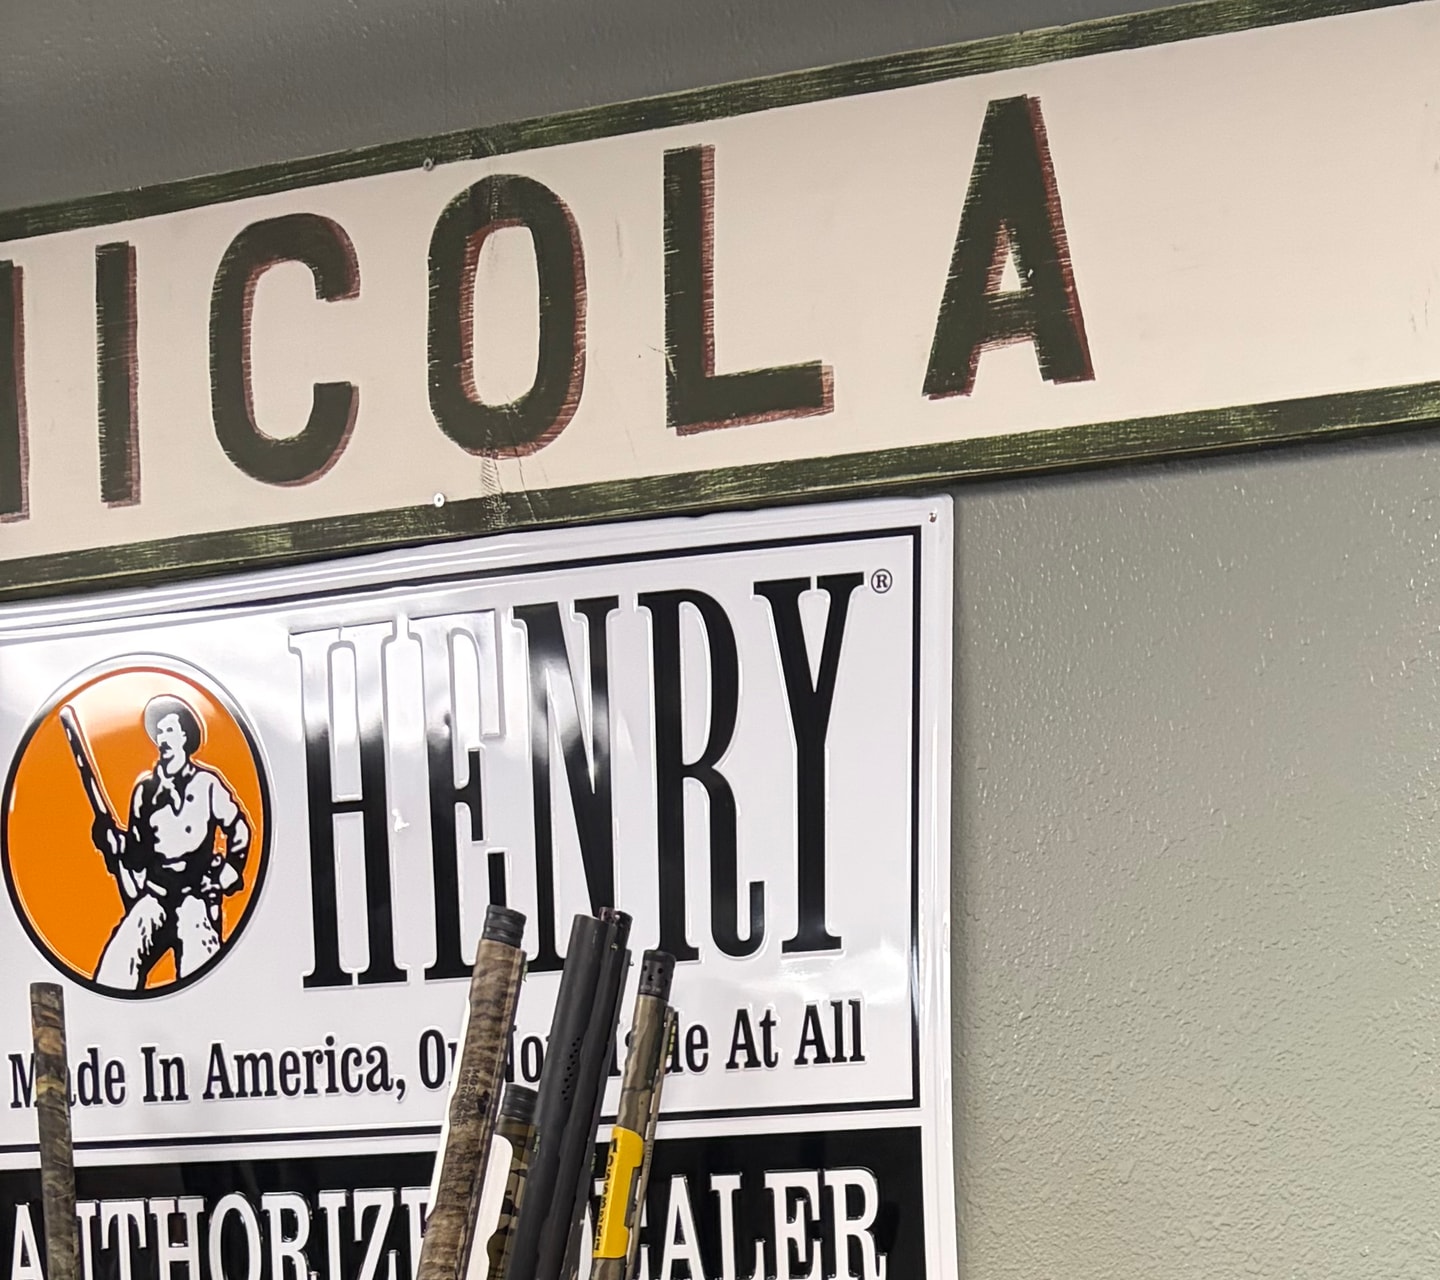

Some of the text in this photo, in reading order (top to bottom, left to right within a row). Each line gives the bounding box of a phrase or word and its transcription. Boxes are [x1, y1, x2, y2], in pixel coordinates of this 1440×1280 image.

[289, 571, 865, 989] HENRY
[8, 1047, 126, 1108] Mde
[141, 1046, 189, 1103] In
[202, 1035, 406, 1101] America,
[726, 1007, 777, 1070] At
[797, 998, 866, 1066] All
